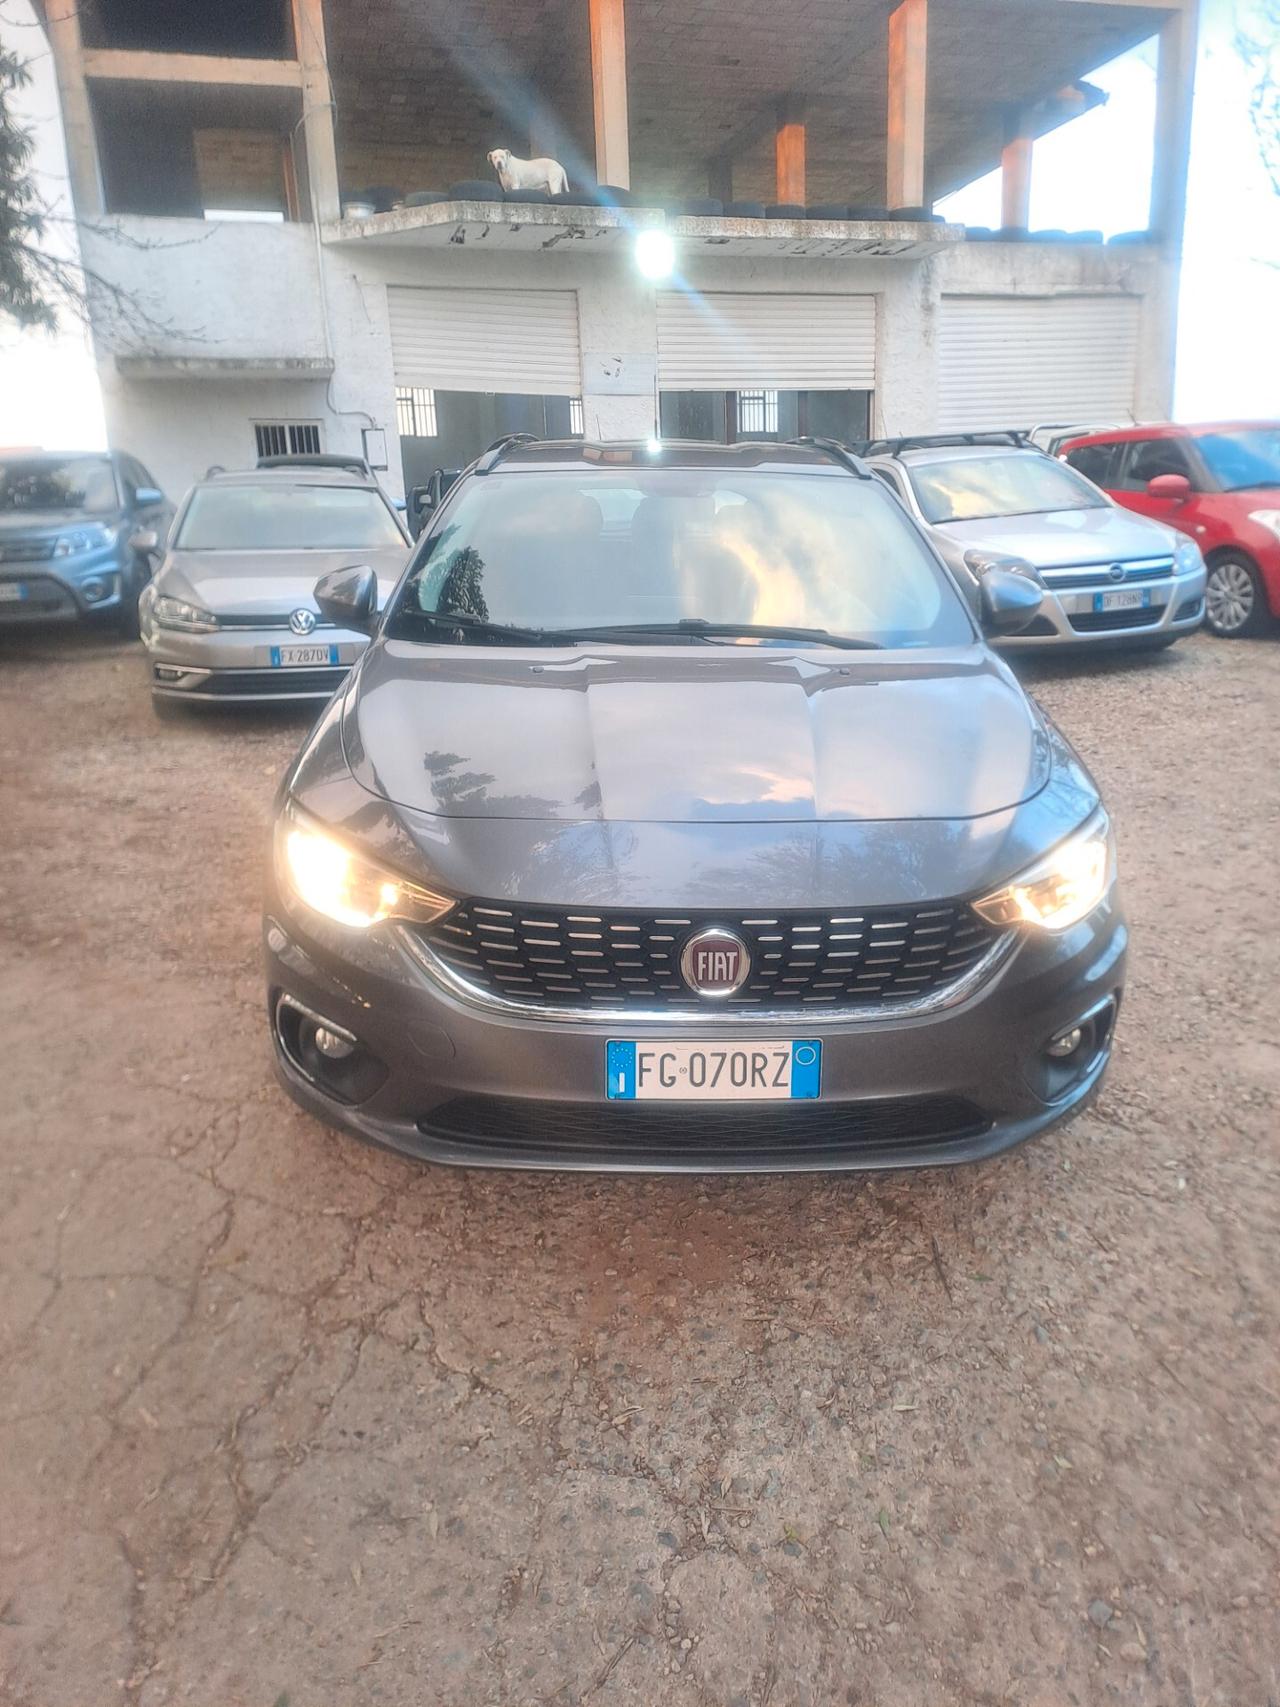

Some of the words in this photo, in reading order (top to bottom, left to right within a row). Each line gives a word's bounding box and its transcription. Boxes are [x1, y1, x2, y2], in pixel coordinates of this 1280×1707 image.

[281, 649, 294, 662] FX
[698, 951, 738, 981] FIAT
[638, 1052, 677, 1088] FG
